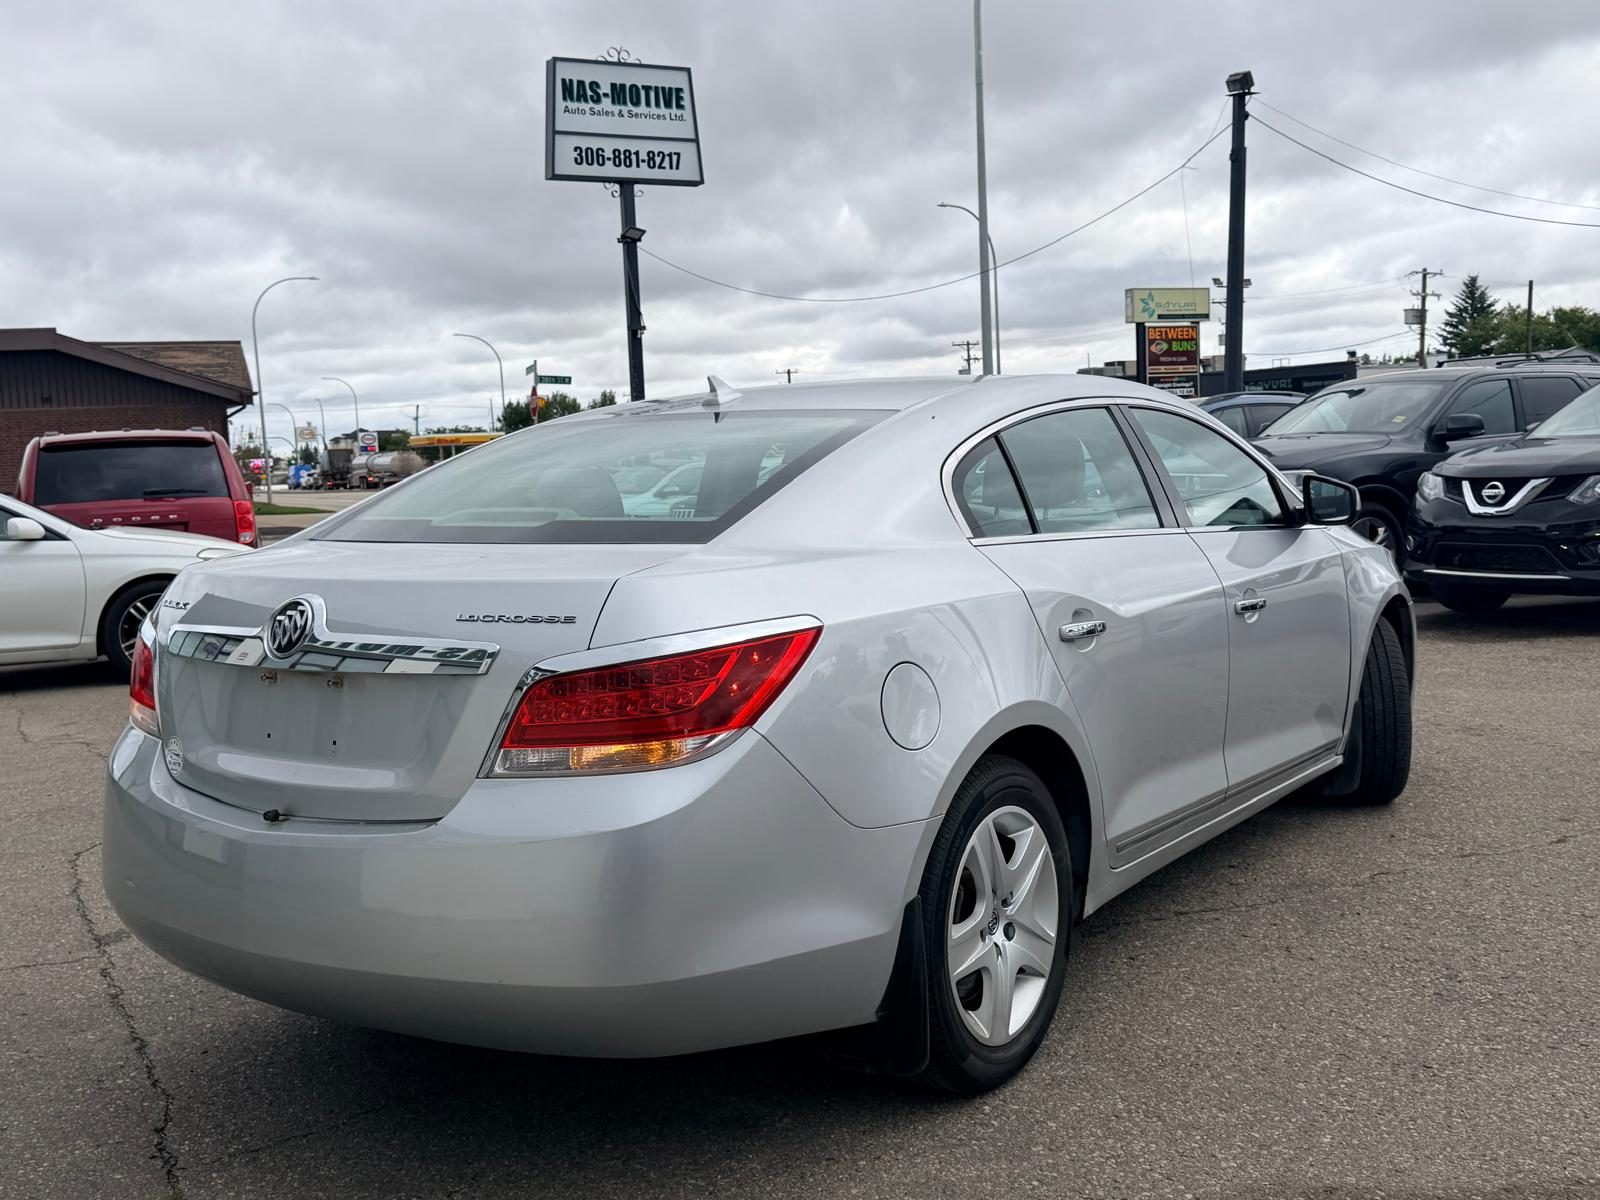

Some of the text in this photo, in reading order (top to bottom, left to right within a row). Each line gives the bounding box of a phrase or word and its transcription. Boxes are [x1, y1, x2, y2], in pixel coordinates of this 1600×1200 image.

[561, 78, 685, 110] NAS-MOTIVE
[563, 106, 686, 122] Auto Sales & Services Ltd.
[573, 146, 681, 170] 306-881-8217
[1148, 328, 1196, 339] BETWEEN
[1172, 341, 1196, 351] BUNS
